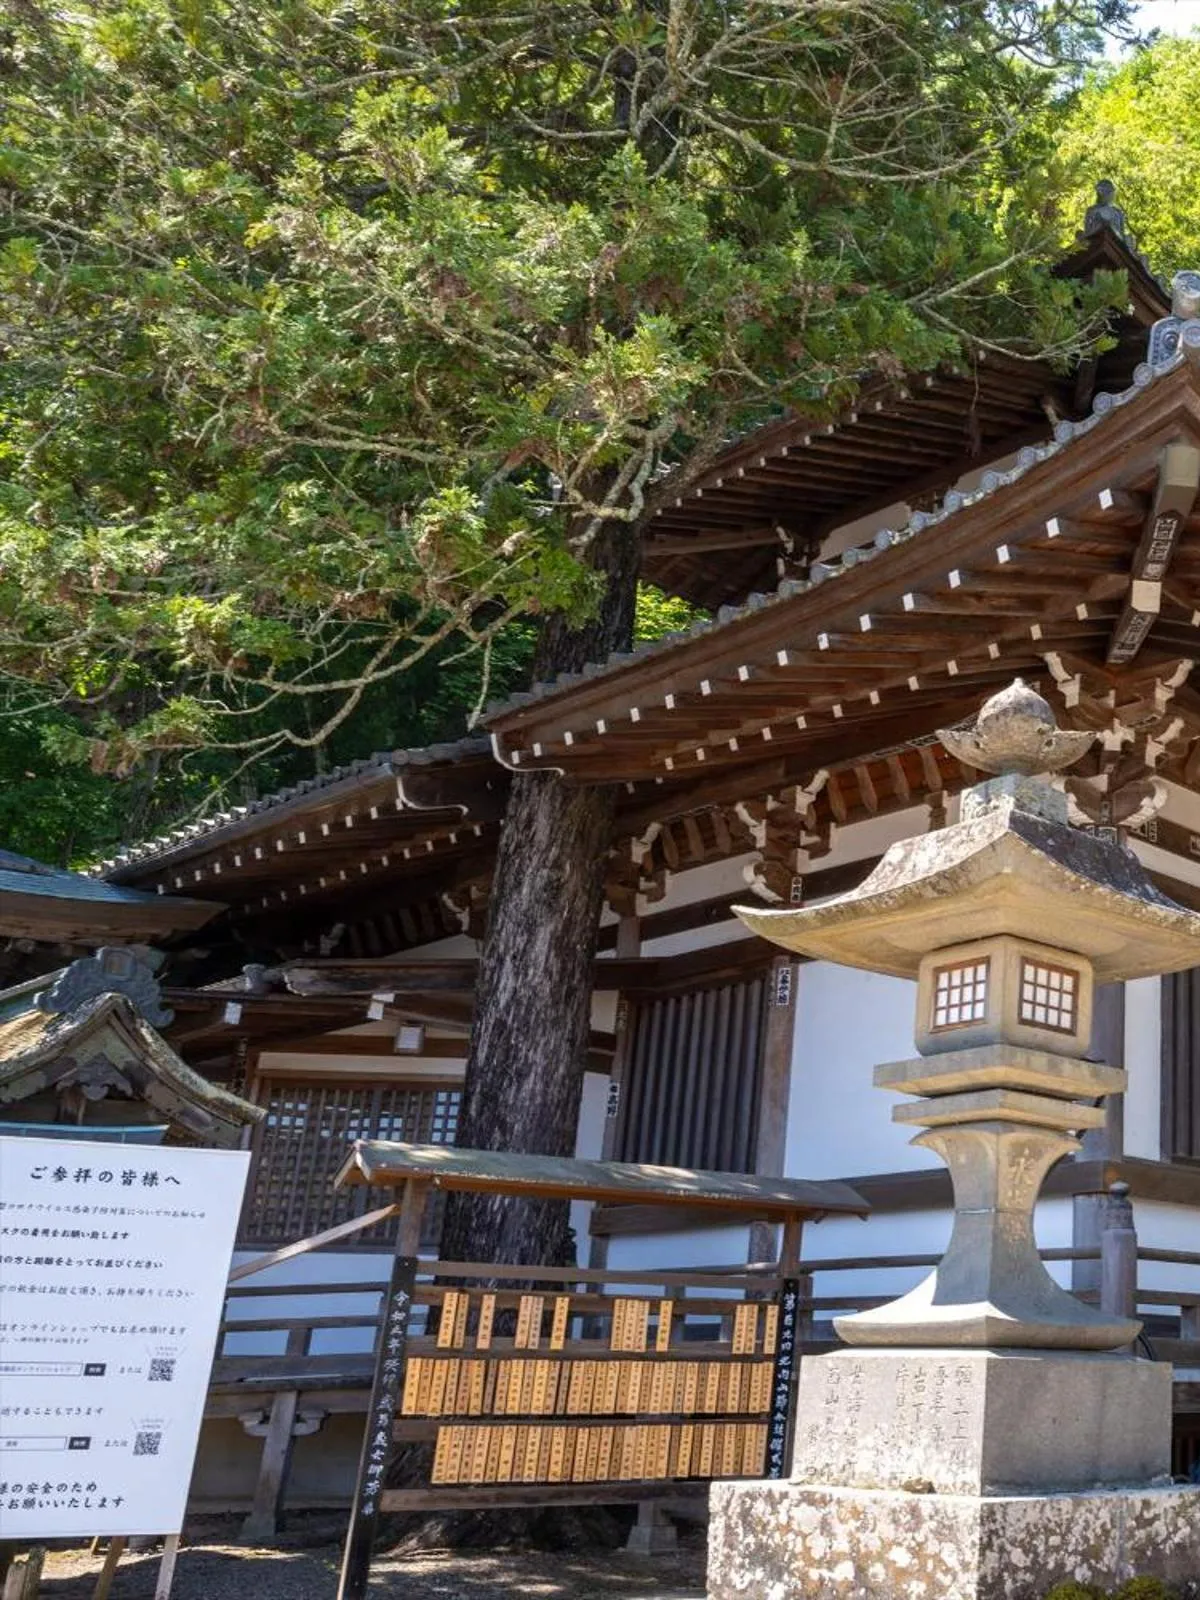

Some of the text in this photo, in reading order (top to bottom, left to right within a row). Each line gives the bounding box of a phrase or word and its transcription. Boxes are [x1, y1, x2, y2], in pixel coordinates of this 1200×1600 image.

[30, 1165, 181, 1188] ご参拝の皆様へ
